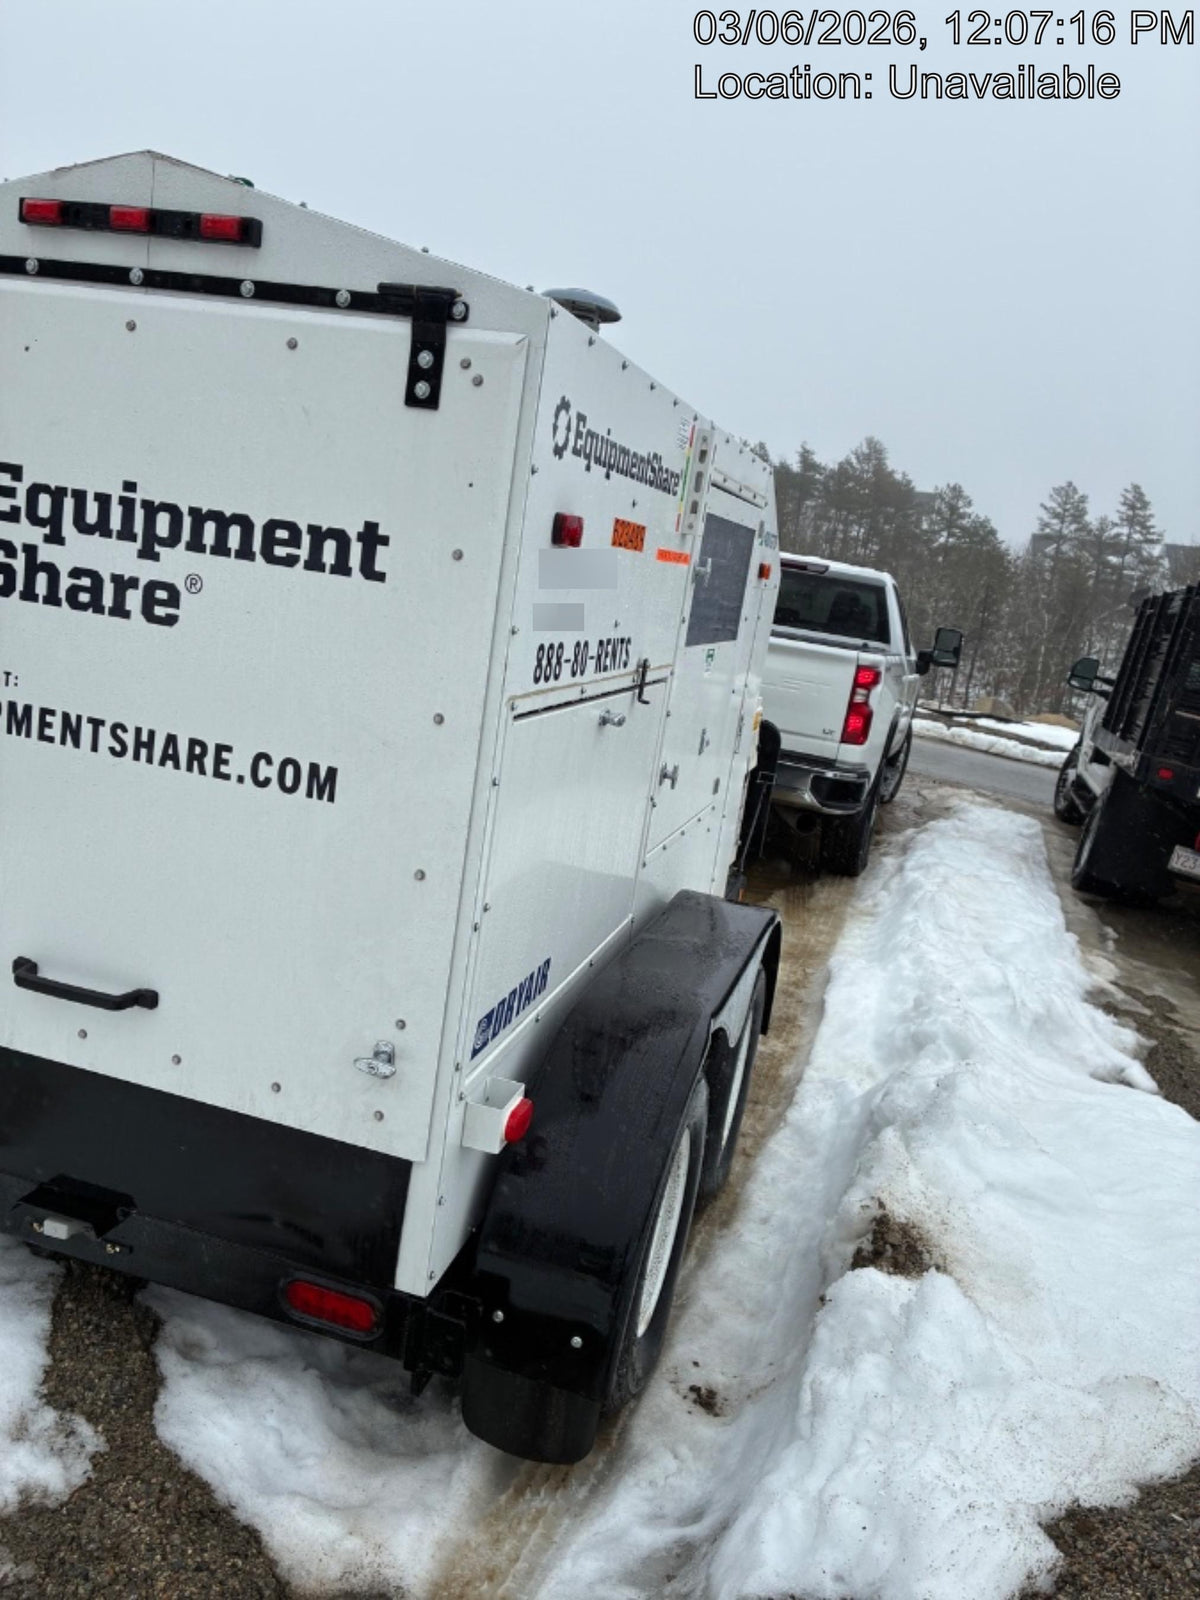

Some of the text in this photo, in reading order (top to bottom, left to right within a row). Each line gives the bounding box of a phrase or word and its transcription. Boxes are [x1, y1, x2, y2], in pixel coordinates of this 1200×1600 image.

[571, 411, 680, 497] EquipmentShare
[533, 637, 631, 685] 888-80-RENTS
[0, 699, 338, 804] MENTSHARE.COM
[490, 957, 551, 1043] DRYAIR
